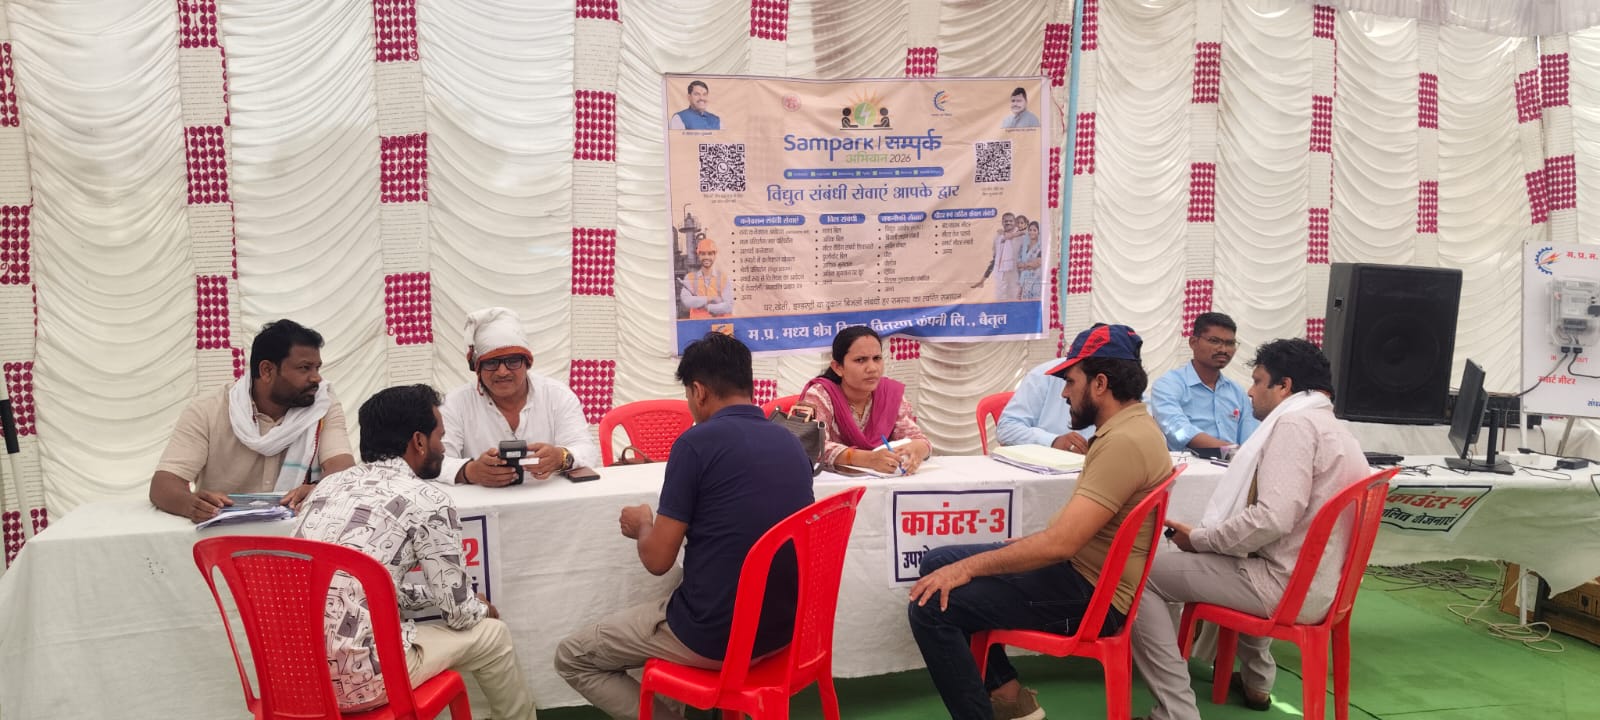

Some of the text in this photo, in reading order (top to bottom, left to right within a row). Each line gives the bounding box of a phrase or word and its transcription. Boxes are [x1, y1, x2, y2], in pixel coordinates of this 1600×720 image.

[784, 134, 874, 162] Sampark
[846, 151, 912, 163] अभियान 2026
[885, 128, 943, 161] सम्पर्क
[767, 183, 960, 206] विद्युत संबंधी सेवाएं आपके द्वार
[782, 325, 810, 339] मध्य
[813, 321, 832, 337] क्षेत्र
[916, 312, 948, 328] कंपनी
[979, 311, 1008, 329] बैतूल
[901, 501, 1005, 536] काउंटर-3
